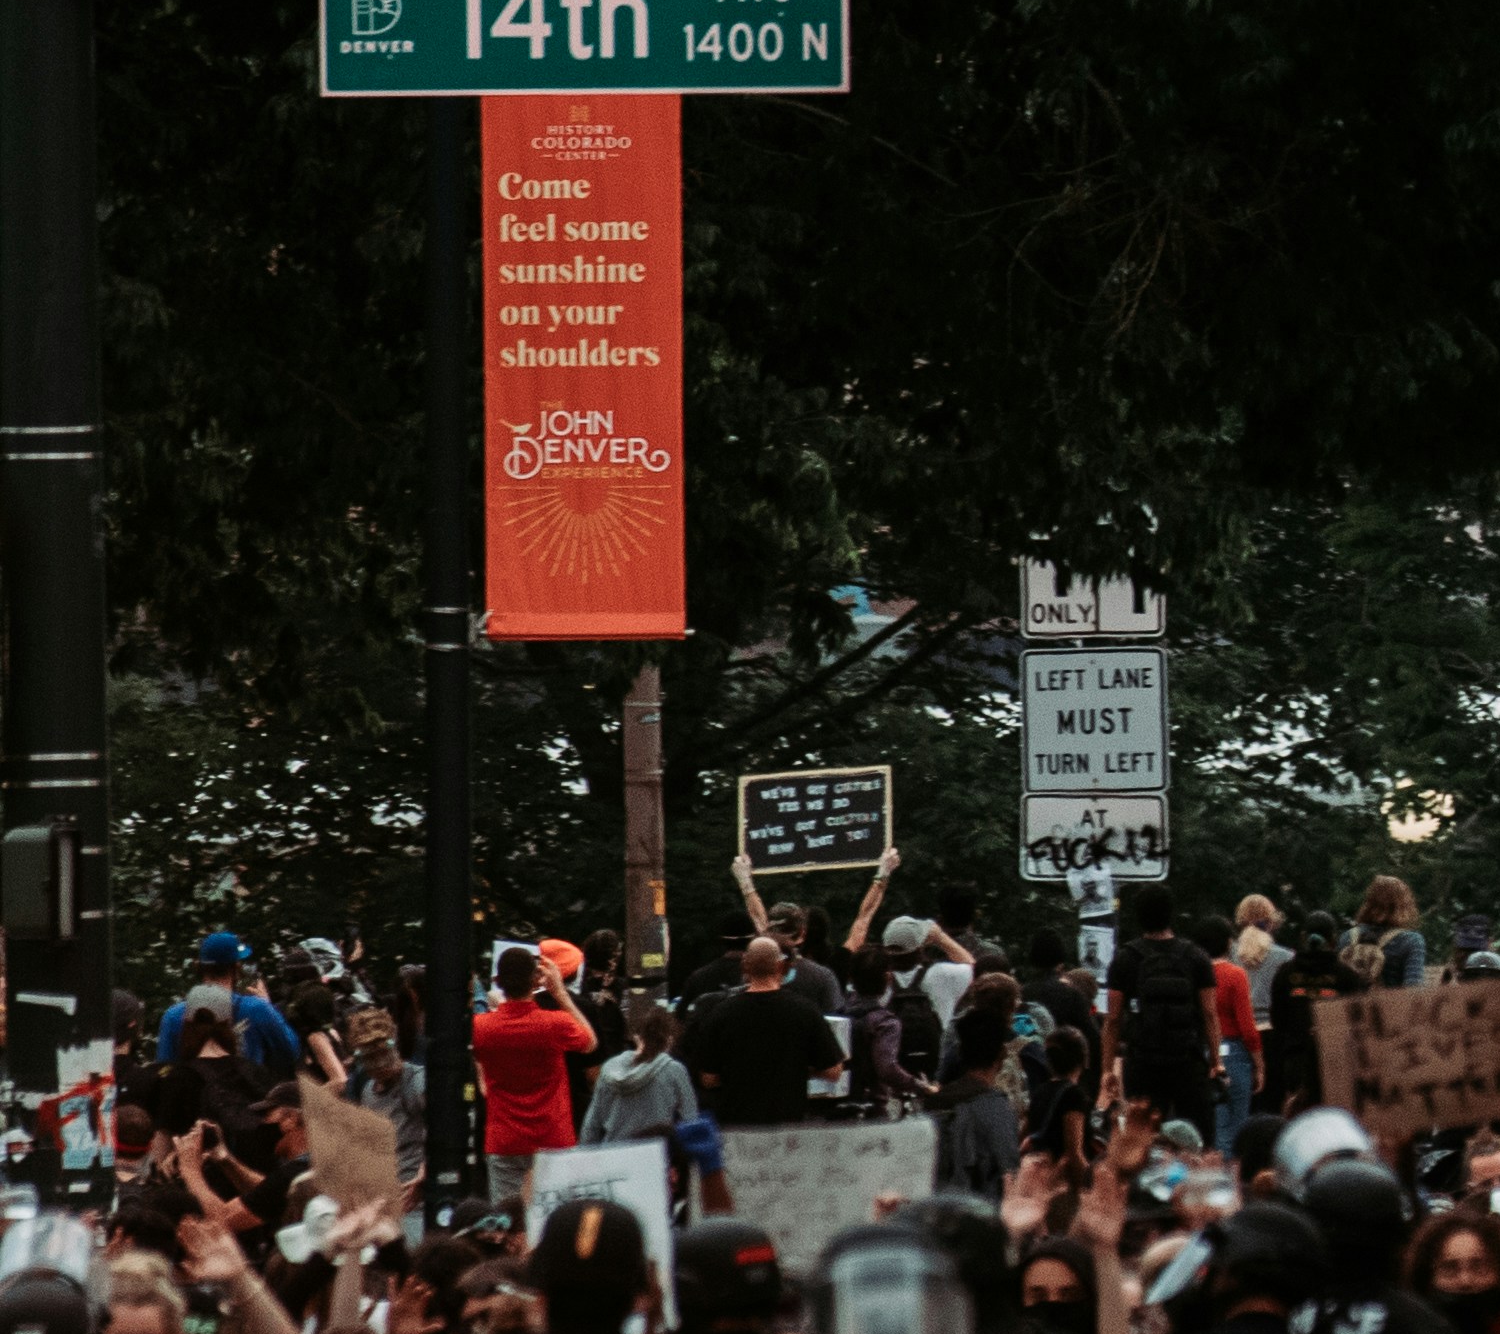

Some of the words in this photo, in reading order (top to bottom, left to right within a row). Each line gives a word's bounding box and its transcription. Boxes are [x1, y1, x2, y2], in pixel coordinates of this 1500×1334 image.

[340, 40, 415, 54] DENVER
[683, 22, 784, 62] 1400
[802, 23, 828, 61] N
[547, 125, 614, 135] HISTORY
[531, 137, 632, 150] COLORADO
[555, 151, 607, 161] CENTER
[498, 172, 591, 200] Come
[500, 213, 556, 242] feel
[563, 220, 650, 242] some
[499, 255, 646, 284] sunshine
[499, 305, 541, 326] on
[548, 305, 625, 333] your
[500, 339, 661, 367] shoulders
[536, 410, 614, 441] JOHN
[503, 436, 672, 480] DENVER
[542, 468, 644, 479] EXPERIENCE
[1031, 603, 1094, 625] ONLY
[1035, 670, 1086, 692] LEFT
[1098, 668, 1154, 690] LANE
[1057, 708, 1133, 735] MUST
[1034, 753, 1090, 775] TURN
[1104, 752, 1155, 774] LEFT
[1080, 809, 1108, 828] AT
